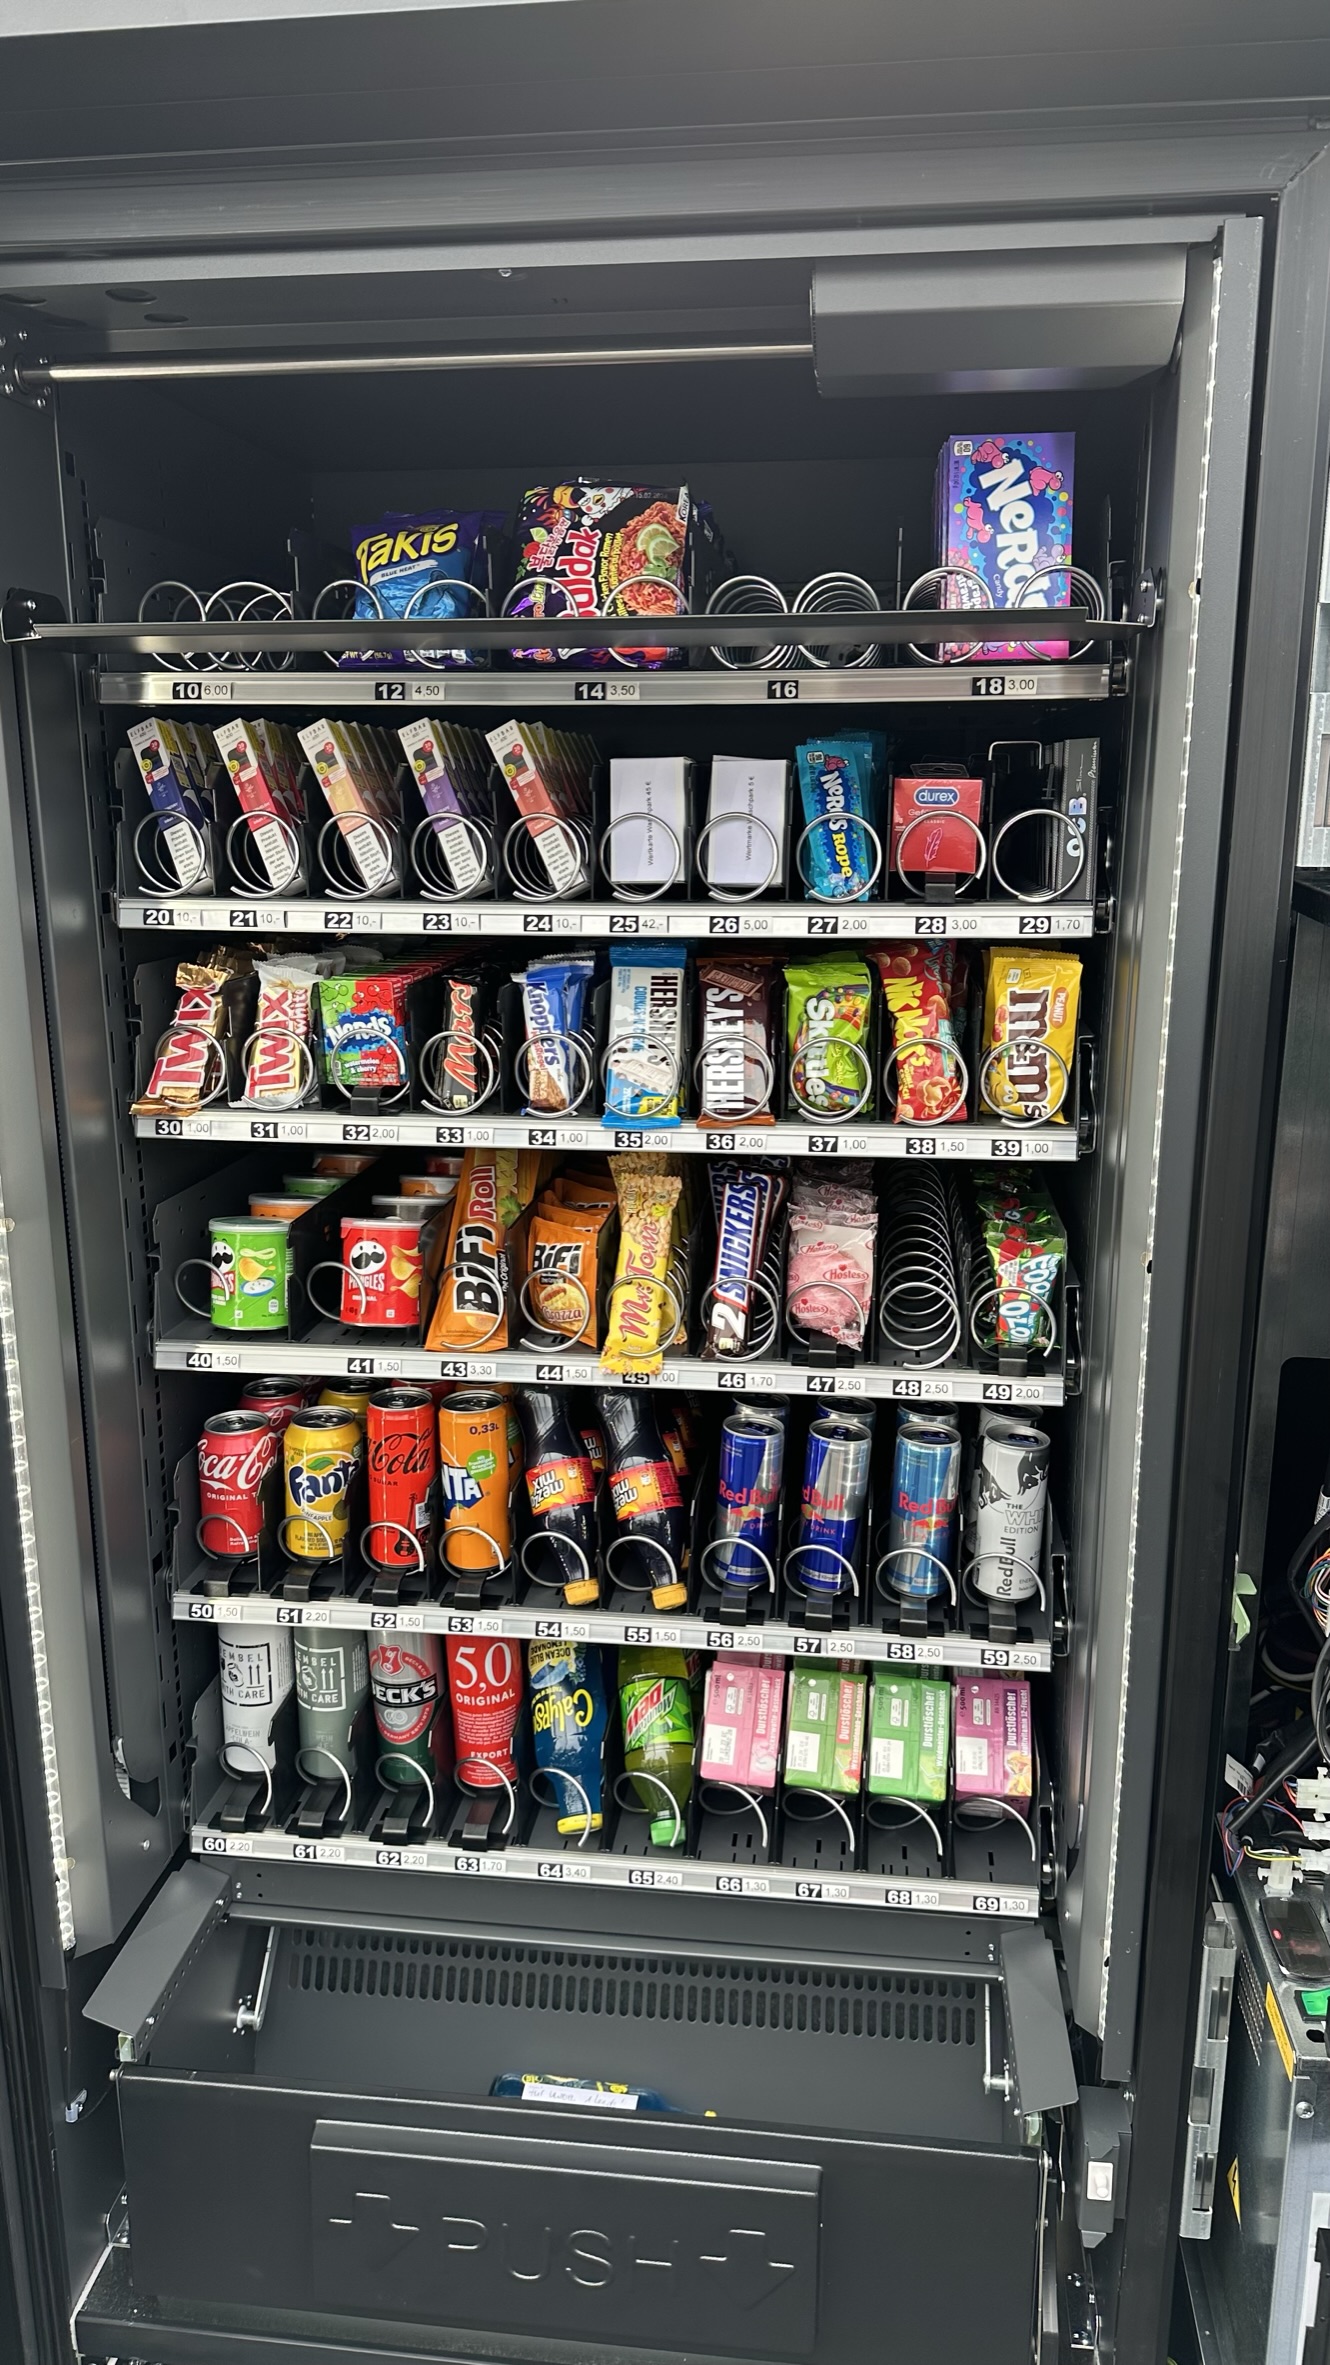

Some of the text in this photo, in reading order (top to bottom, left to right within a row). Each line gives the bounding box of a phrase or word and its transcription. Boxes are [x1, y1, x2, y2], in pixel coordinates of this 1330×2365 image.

[356, 523, 459, 586] Takis
[598, 532, 614, 587] Flavor Ramen
[380, 571, 397, 579] BLUE
[993, 572, 1004, 598] Candy
[176, 683, 229, 698] 10 6,00
[378, 684, 440, 699] 12 4,50
[578, 684, 635, 699] 14 3,50
[771, 682, 797, 698] 16
[976, 678, 1034, 694] 18 3,00
[216, 723, 240, 739] ELFBAR
[918, 788, 955, 804] durex
[145, 911, 171, 925] 20
[232, 912, 257, 926] 21
[327, 913, 352, 928] 22
[426, 915, 450, 930] 23
[526, 916, 551, 931] 24
[611, 917, 638, 932] 25
[711, 918, 769, 932] 26 5,00
[811, 918, 867, 932] 27 2,00
[1022, 917, 1081, 932] 29 1,70
[918, 918, 977, 933] 28 3,00
[634, 985, 648, 1015] COOKIES
[291, 988, 309, 1035] white
[1055, 992, 1067, 1023] PEANUT
[527, 981, 560, 1066] Knoppers
[443, 979, 479, 1093] Mars
[706, 987, 745, 1109] HERSHEY'S
[158, 1121, 181, 1134] 30
[253, 1123, 276, 1137] 31
[345, 1125, 394, 1140] 32 2,00
[438, 1128, 463, 1142] 33
[530, 1130, 555, 1144] 34
[617, 1132, 668, 1147] 35 2,00
[708, 1135, 734, 1149] 36
[811, 1137, 867, 1151] 37 1,00
[908, 1139, 964, 1154] 38 1,50
[994, 1141, 1049, 1155] 39 1,00
[468, 1166, 497, 1222] Roll
[718, 1182, 760, 1303] SNICKERS
[618, 1220, 661, 1343] Mr. Tom
[829, 1268, 868, 1281] Hostess
[792, 1303, 828, 1315] Hostess
[711, 1302, 747, 1340] 2
[187, 1354, 211, 1367] 40
[350, 1359, 373, 1372] 41
[443, 1362, 467, 1376] 43
[538, 1366, 561, 1380] 44
[624, 1373, 648, 1384] 45
[720, 1374, 773, 1387] 46 1,70
[809, 1377, 833, 1391] 47
[895, 1381, 948, 1396] 48 2,50
[985, 1385, 1040, 1399] 49 2,00
[206, 1492, 249, 1501] ORIGINAL
[719, 1480, 748, 1505] Red
[811, 1488, 845, 1511] Bull
[898, 1491, 931, 1513] Red
[1006, 1502, 1024, 1510] THE
[810, 1524, 837, 1536] DRINK
[1004, 1526, 1039, 1535] EDITION
[996, 1535, 1017, 1597] Red Bull
[191, 1605, 212, 1618] 50
[278, 1610, 328, 1623] 51 2,20
[373, 1614, 395, 1628] 52
[450, 1618, 473, 1632] 53
[537, 1622, 561, 1636] 54
[626, 1628, 650, 1641] 55
[709, 1633, 761, 1647] 56 2,50
[796, 1639, 853, 1653] 57 2,50
[550, 1648, 571, 1661] OCEAN
[889, 1644, 941, 1658] 58 2,50
[983, 1651, 1037, 1665] 59 2,50
[455, 1642, 512, 1692] 5,0
[238, 1689, 265, 1699] CARE
[311, 1693, 338, 1703] CARE
[455, 1688, 516, 1706] ORIGINAL
[756, 1678, 771, 1735] Durstlöscher
[838, 1683, 855, 1741] Durstlöscher
[922, 1691, 935, 1748] Durstlöscher
[1007, 1691, 1017, 1747] Durstlöscher
[935, 1690, 947, 1767] Waldmeister-Geschmack
[470, 1749, 509, 1760] EXPORT
[204, 1837, 226, 1851] 60
[295, 1846, 317, 1859] 61
[377, 1852, 400, 1866] 62
[457, 1858, 479, 1872] 63
[539, 1864, 562, 1878] 64
[630, 1871, 654, 1885] 65
[718, 1877, 741, 1891] 66
[797, 1883, 821, 1897] 67
[887, 1890, 911, 1905] 68
[975, 1897, 999, 1911] 69
[442, 2216, 678, 2294] PUSH
